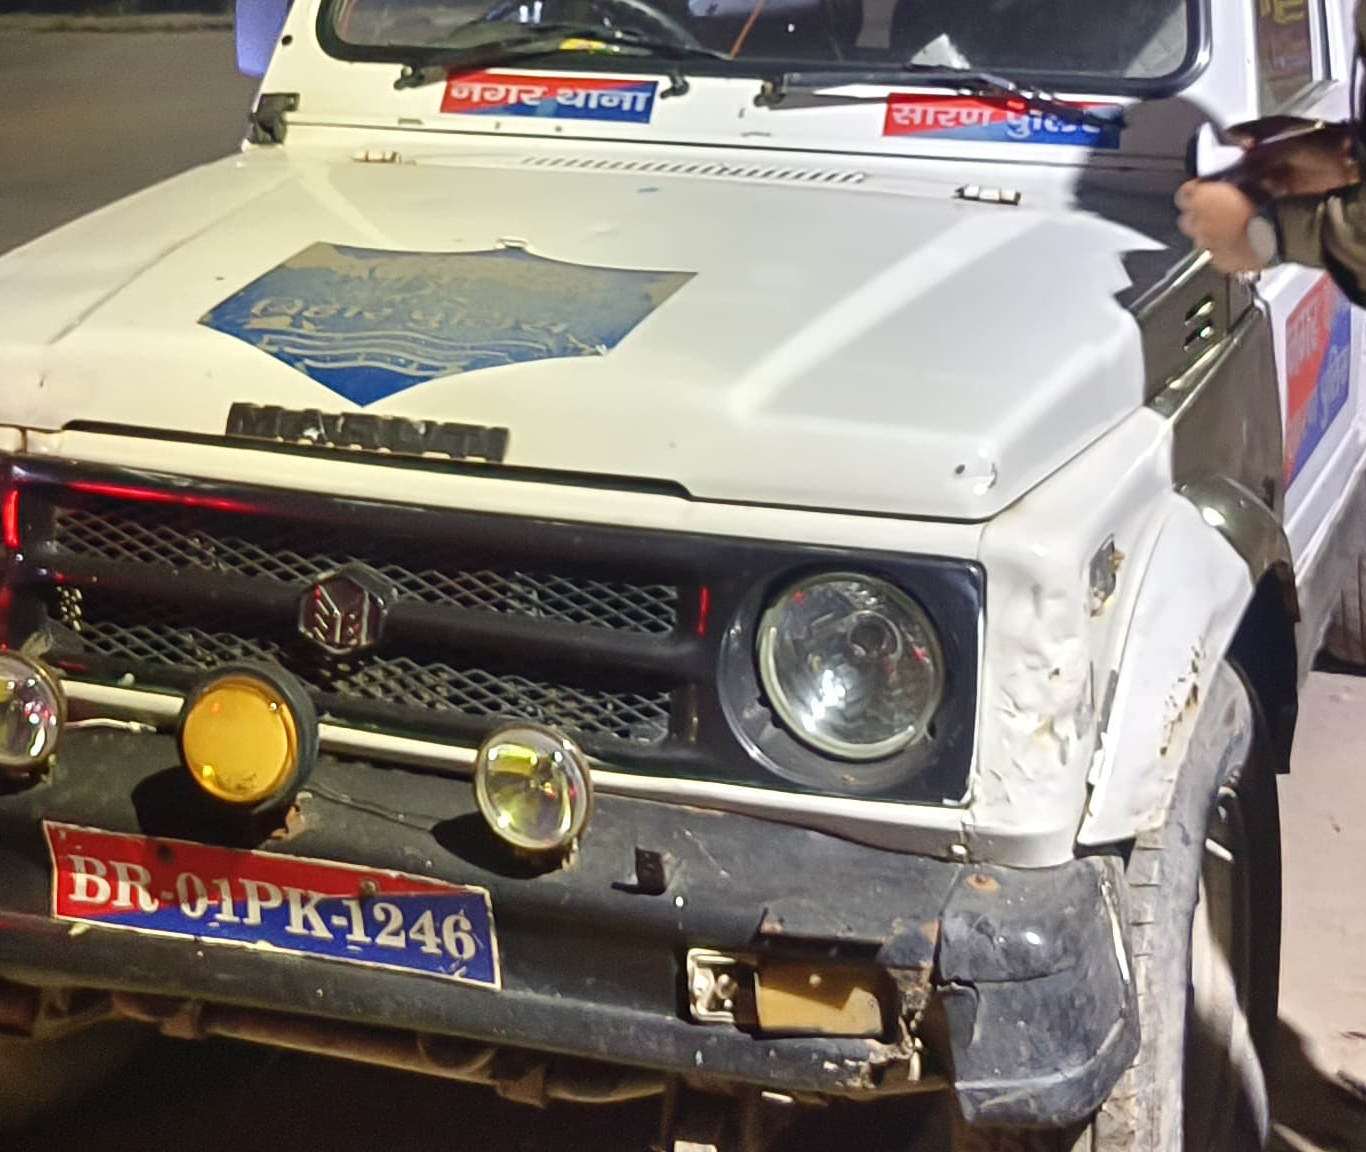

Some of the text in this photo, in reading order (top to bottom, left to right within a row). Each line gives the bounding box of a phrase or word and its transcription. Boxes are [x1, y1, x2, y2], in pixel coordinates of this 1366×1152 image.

[450, 80, 651, 113] नगर थाना
[892, 104, 993, 128] सारण
